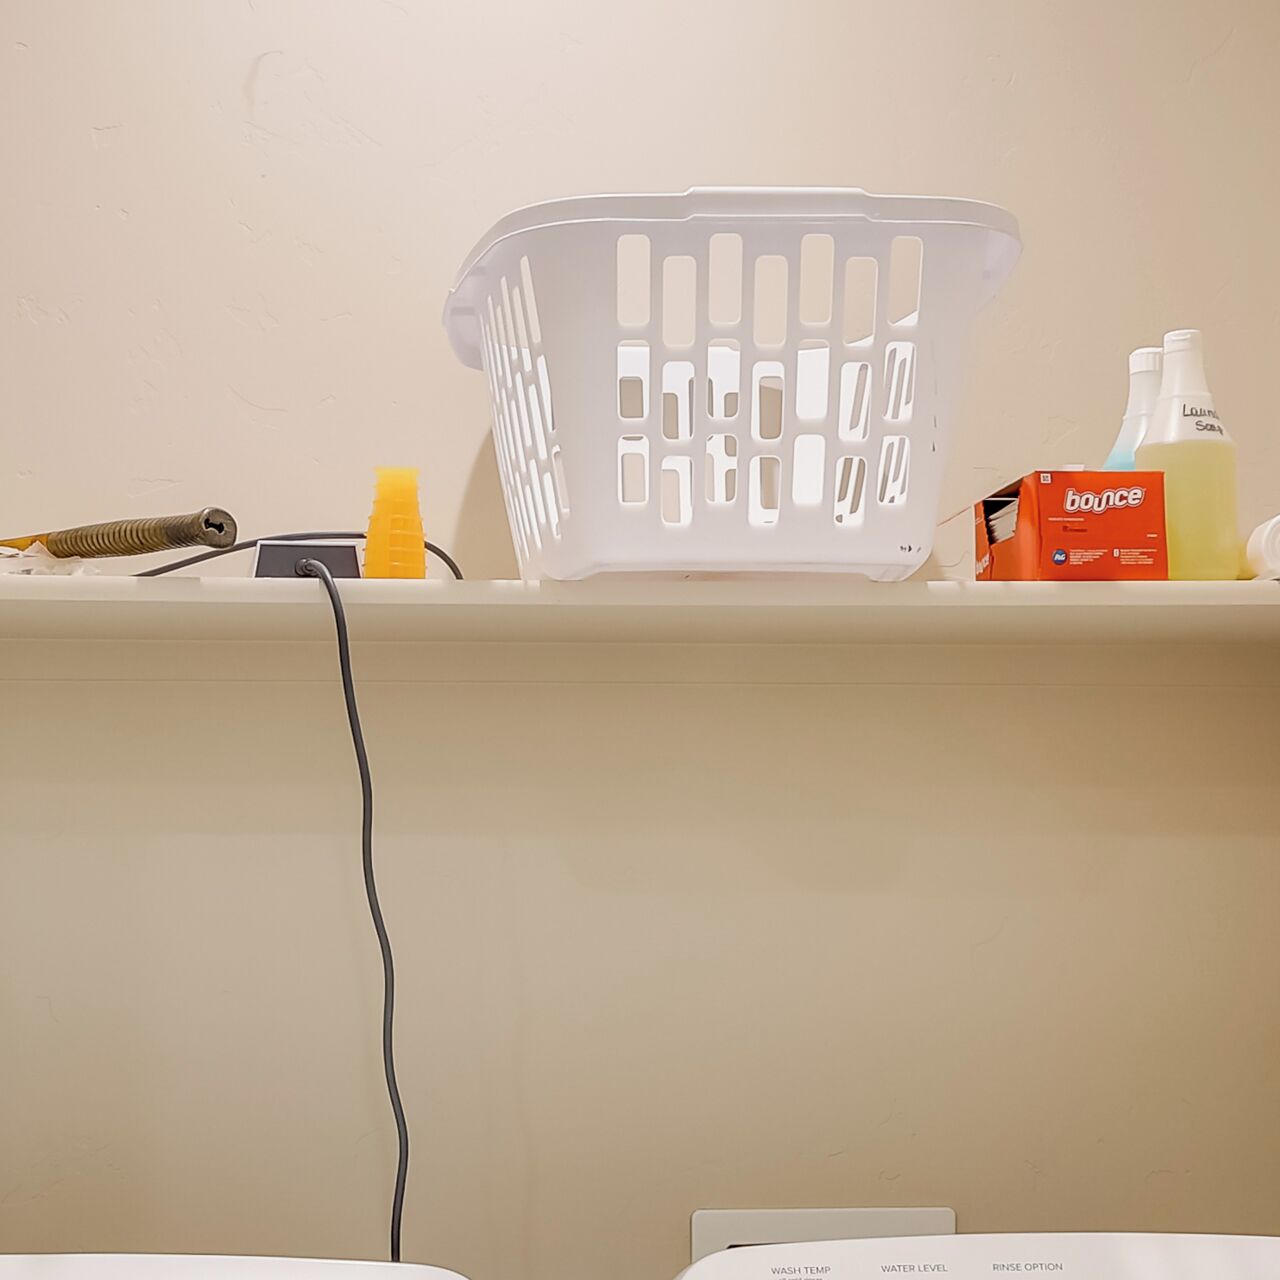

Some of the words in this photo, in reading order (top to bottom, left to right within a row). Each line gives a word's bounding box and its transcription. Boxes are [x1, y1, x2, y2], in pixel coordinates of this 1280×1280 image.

[1064, 487, 1145, 513] bounce
[770, 1266, 801, 1275] WASH
[804, 1266, 831, 1275] TEMP
[880, 1264, 916, 1273] WATER
[918, 1264, 948, 1272] LEVEL
[992, 1263, 1023, 1272] RINSE
[1024, 1262, 1063, 1271] OPTION
